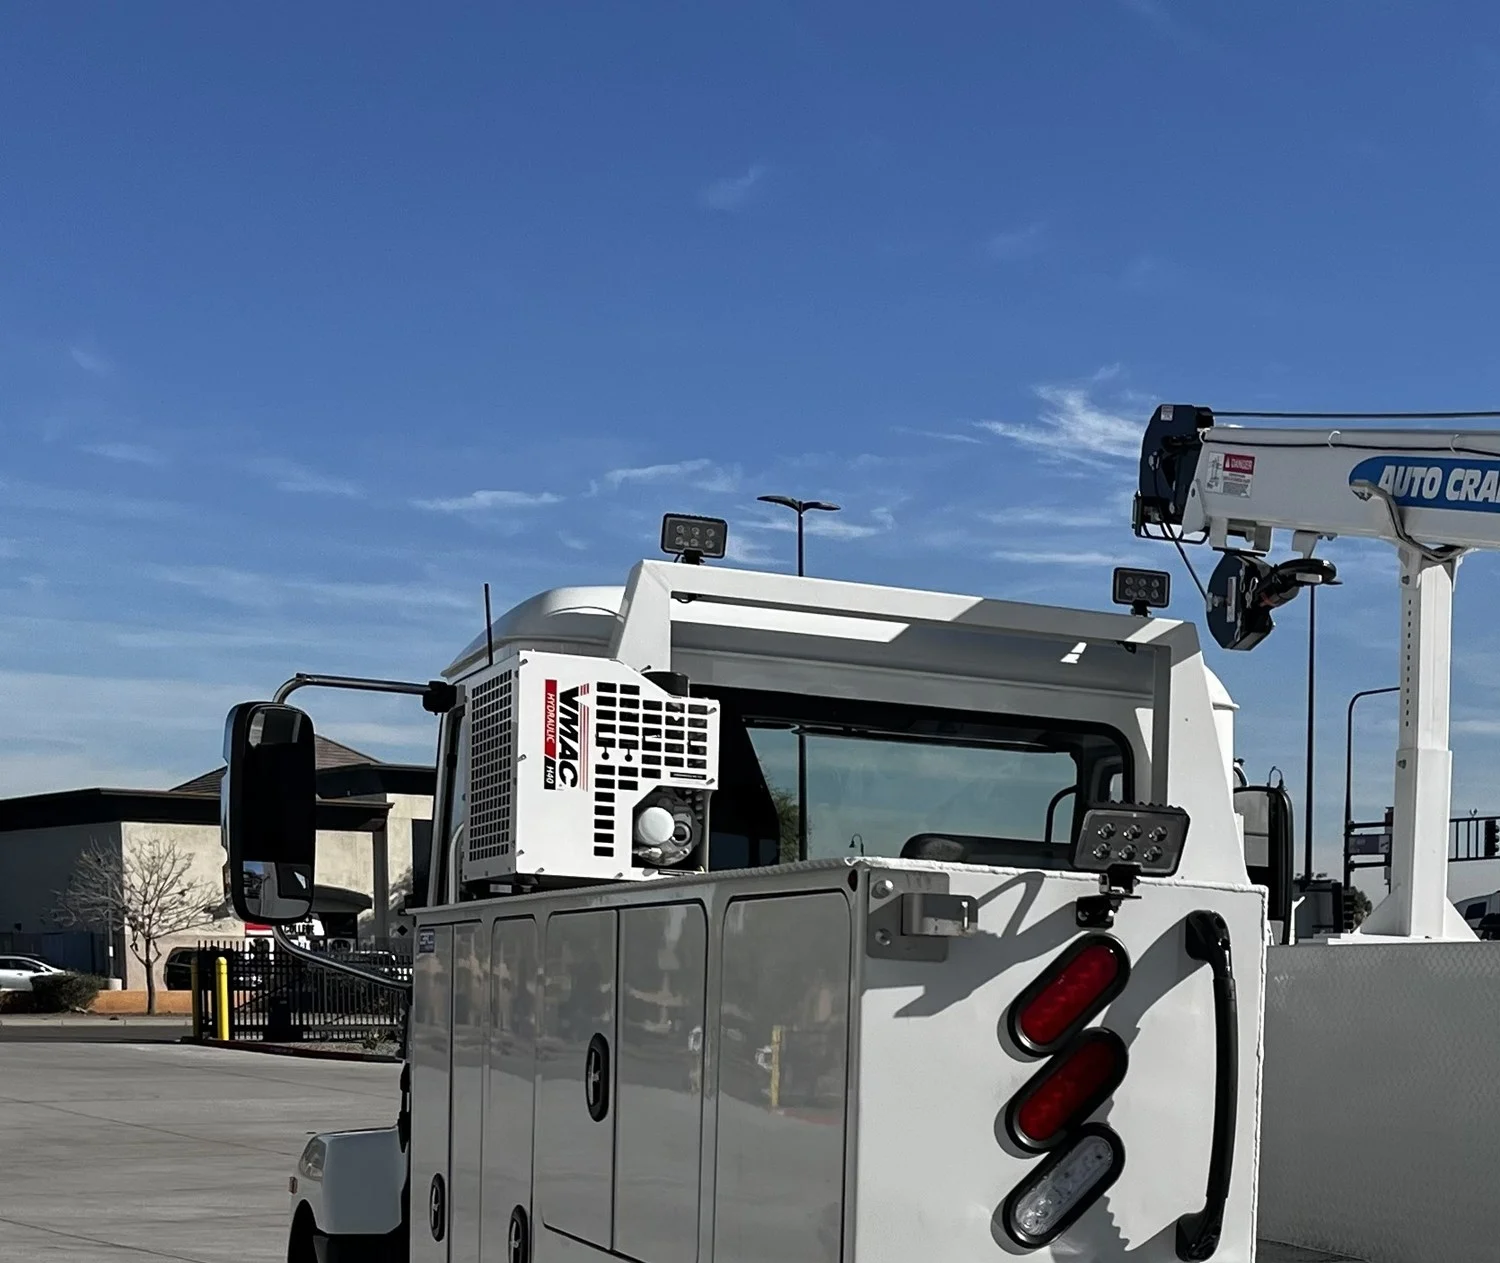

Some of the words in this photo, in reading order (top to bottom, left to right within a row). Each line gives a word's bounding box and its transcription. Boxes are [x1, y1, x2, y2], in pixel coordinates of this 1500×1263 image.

[1378, 465, 1443, 499] AUTO
[546, 692, 555, 744] HYDRAULIC
[559, 686, 579, 788] VMAC
[545, 765, 554, 784] H40
